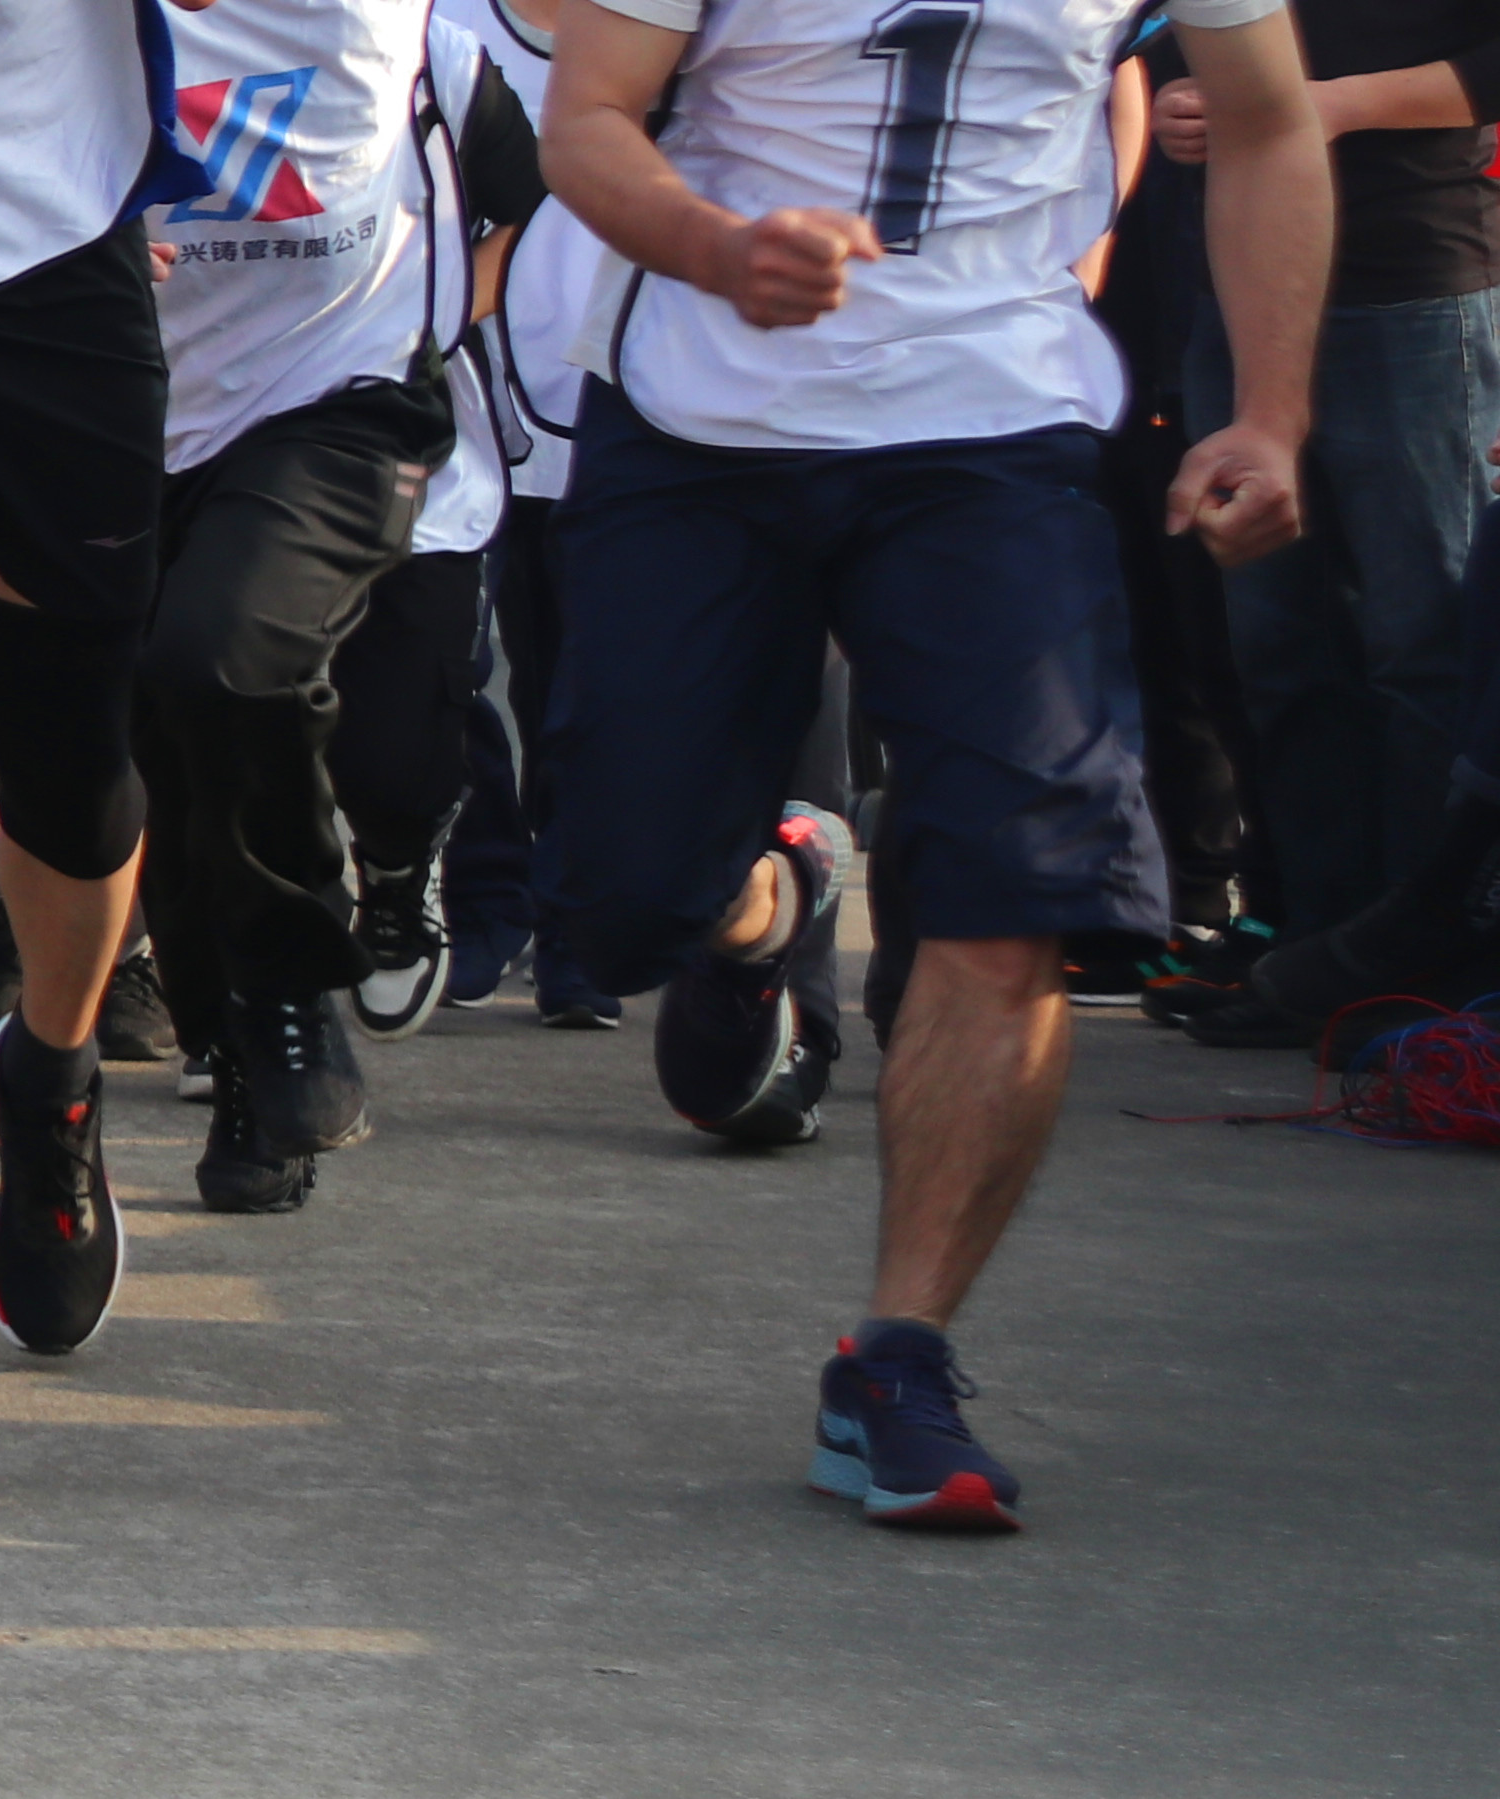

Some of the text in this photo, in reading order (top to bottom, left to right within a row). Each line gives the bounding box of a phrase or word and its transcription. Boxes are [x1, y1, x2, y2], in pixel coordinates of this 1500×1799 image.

[169, 214, 377, 267] 兴铸管有限公司
